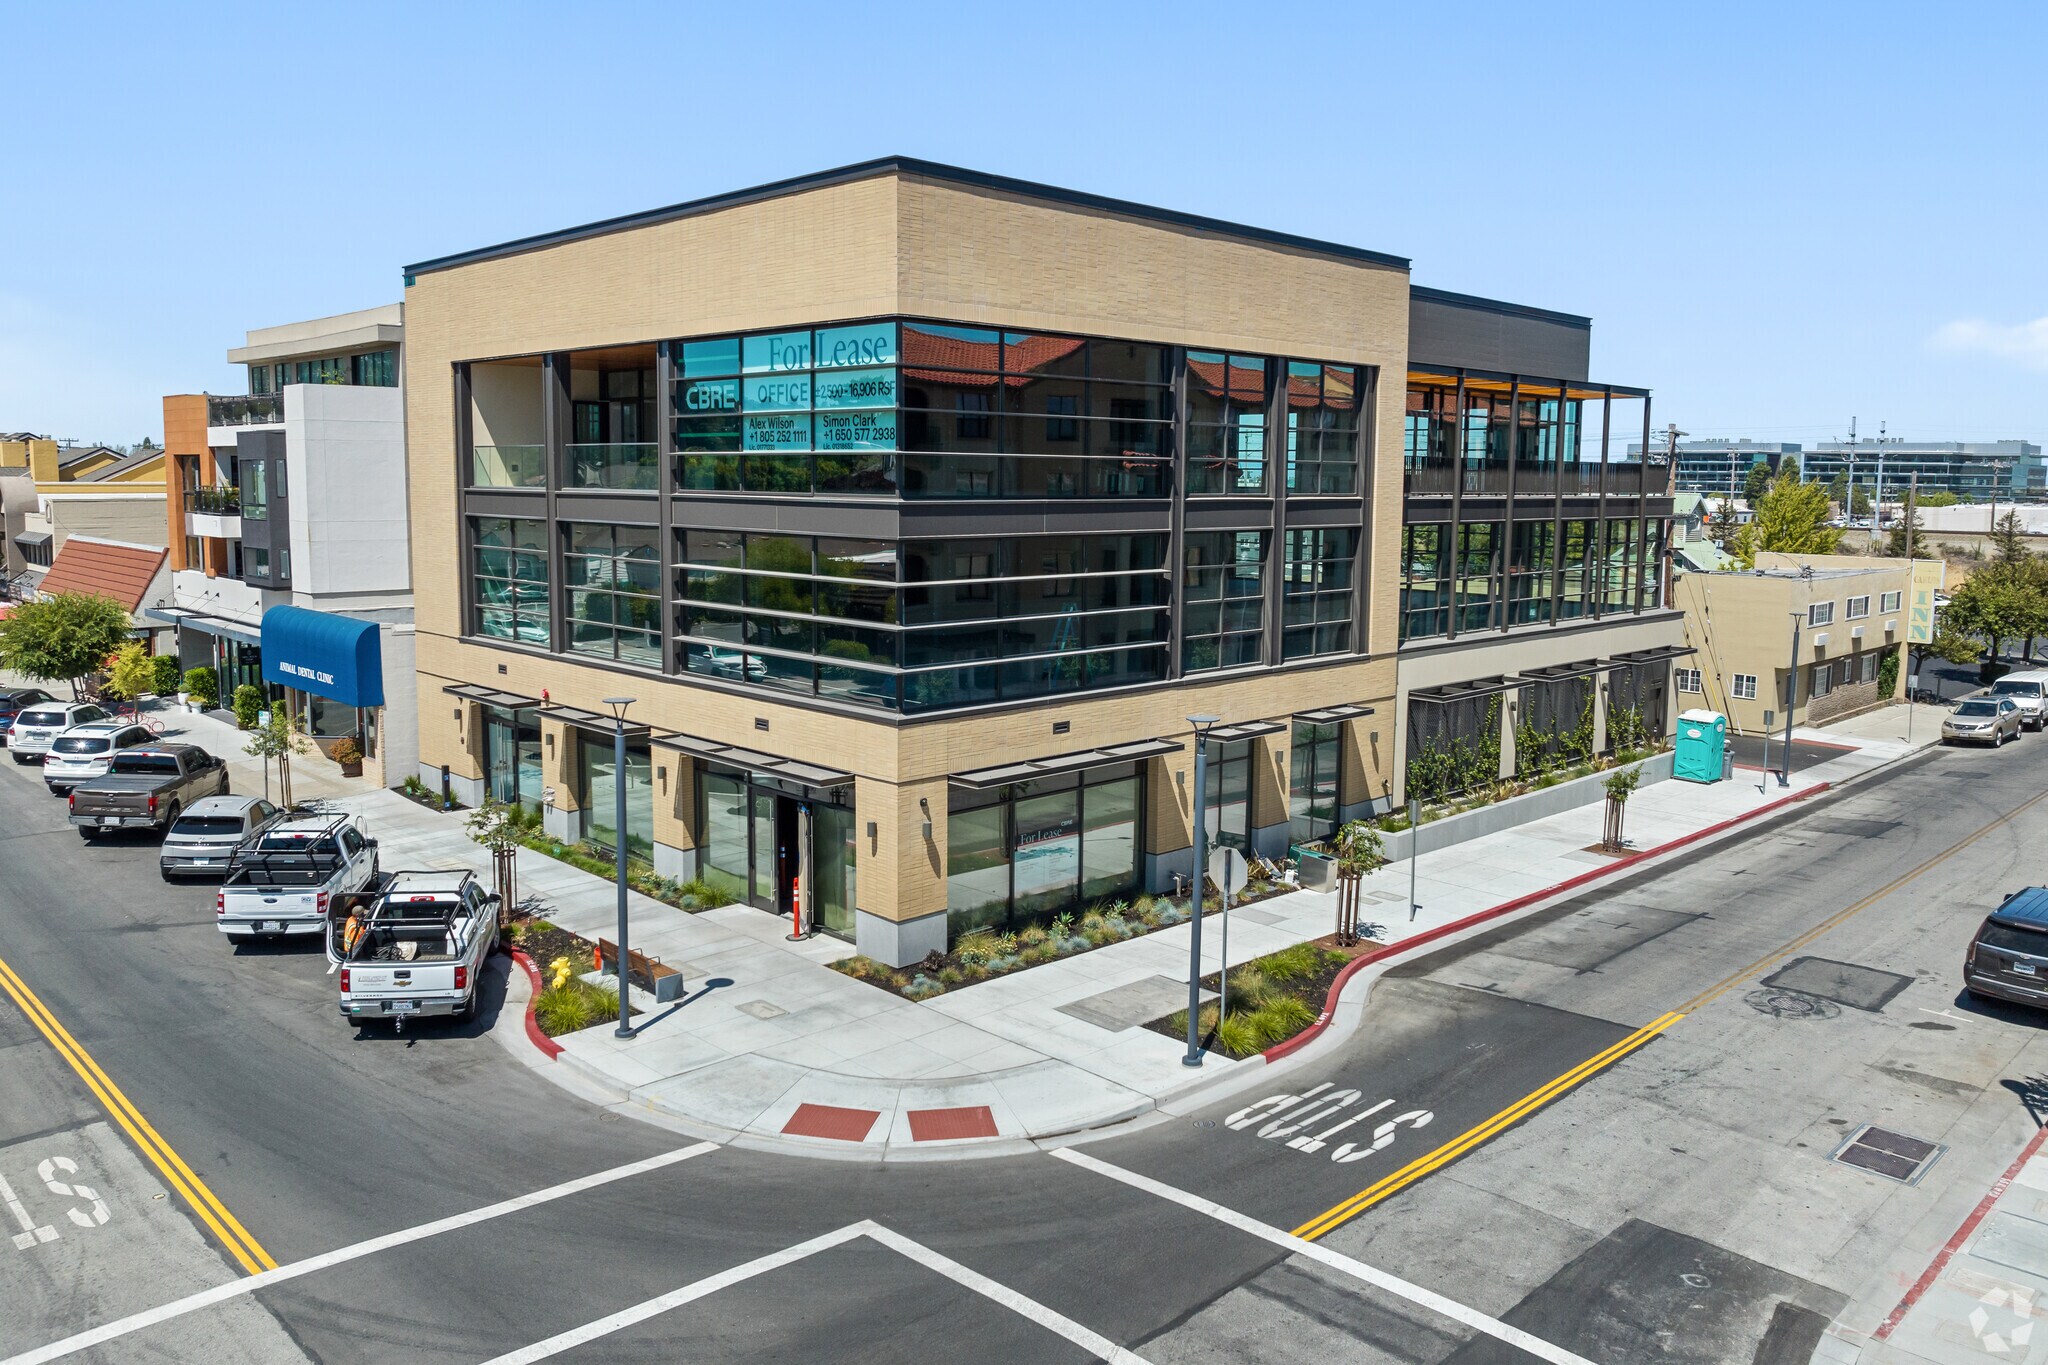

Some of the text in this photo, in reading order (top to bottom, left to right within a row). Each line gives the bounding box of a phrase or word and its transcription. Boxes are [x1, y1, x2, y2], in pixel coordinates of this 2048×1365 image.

[768, 332, 887, 371] For Lease
[686, 384, 735, 410] CBRE
[758, 382, 808, 402] OFFICE
[849, 381, 877, 400] 16,906
[877, 380, 896, 396] RSF
[749, 416, 795, 429] Alex Wilson
[823, 413, 877, 428] Simon Clark
[749, 430, 807, 442] +1 805 252 1111
[823, 427, 896, 441] +1 650 577 2938
[1909, 591, 1931, 640] INN
[280, 661, 334, 685] ANIMAL DENTAL CLINIC
[1020, 829, 1062, 845] For Lease
[1225, 1082, 1435, 1163] STOP
